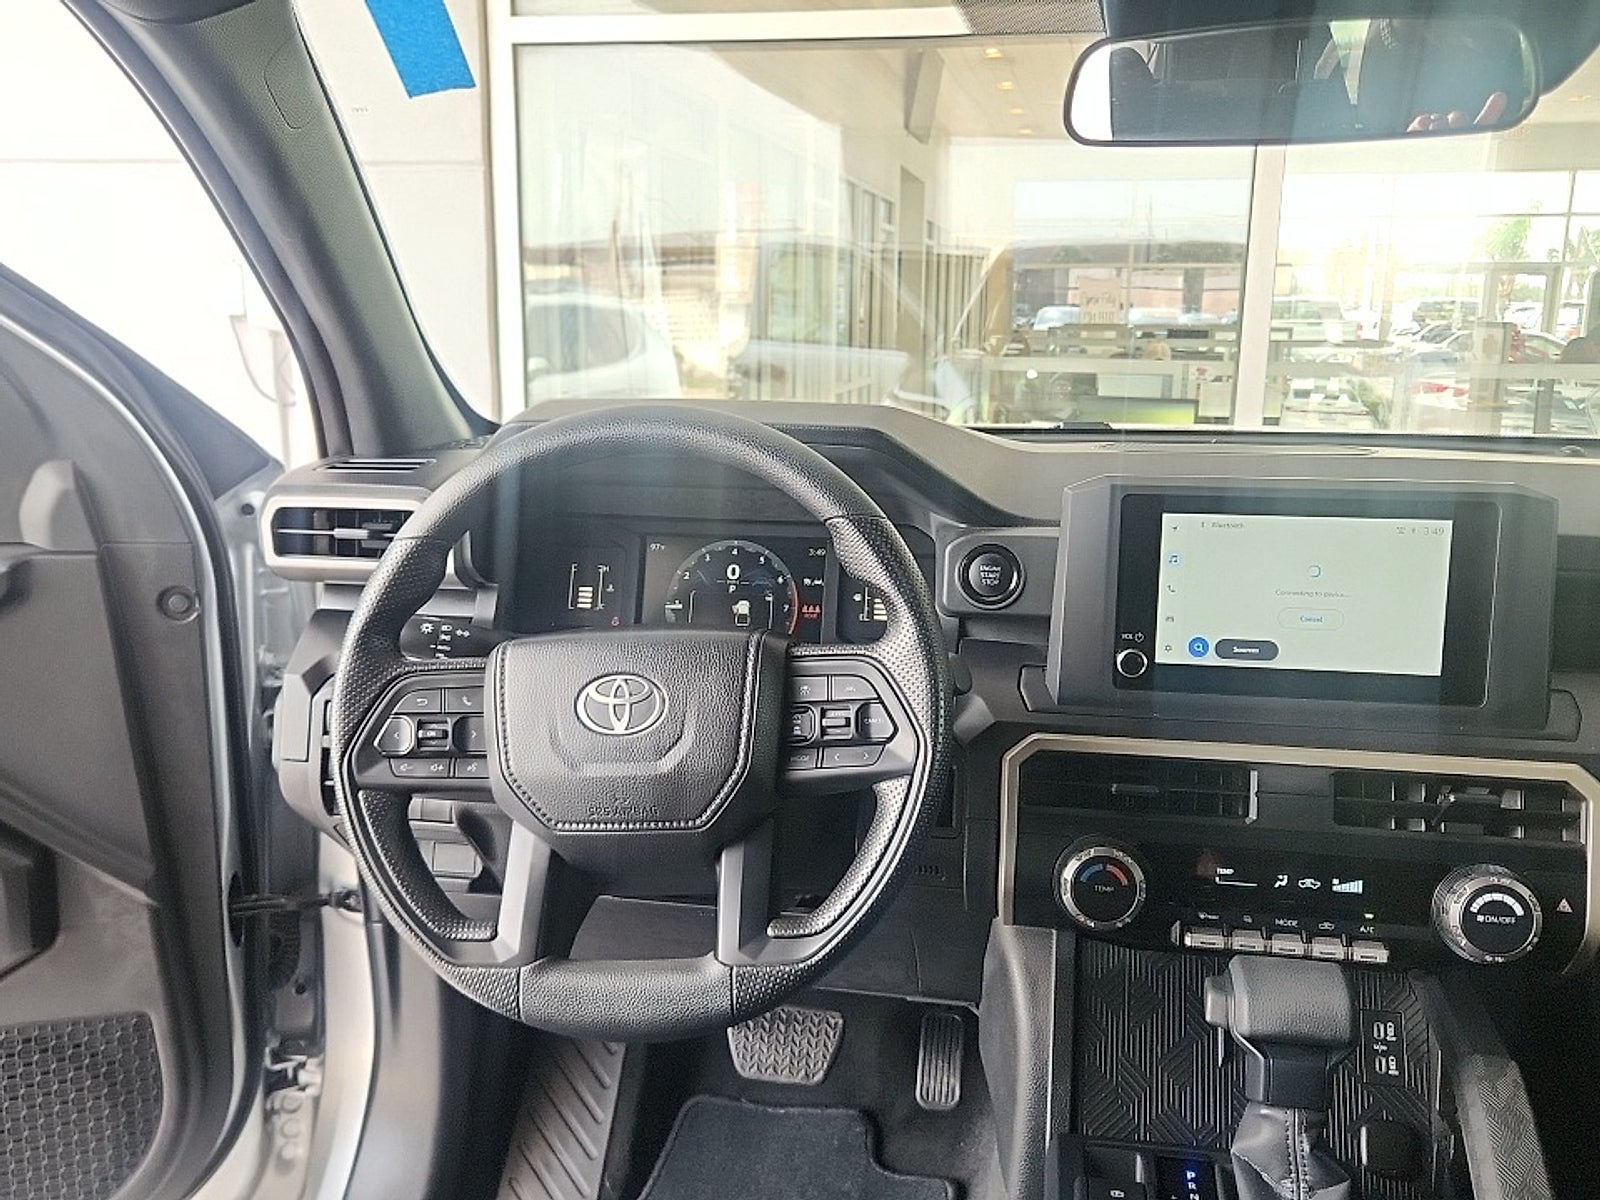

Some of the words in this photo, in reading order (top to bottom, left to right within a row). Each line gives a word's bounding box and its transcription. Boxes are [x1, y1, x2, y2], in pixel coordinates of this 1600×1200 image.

[1423, 526, 1445, 536] 3:49
[731, 548, 738, 556] 4
[759, 556, 766, 565] 5
[683, 572, 690, 580] 2
[726, 564, 740, 580] 0
[729, 584, 737, 593] P
[1275, 918, 1299, 928] MODE
[1484, 914, 1517, 925] ON/OFF
[1359, 925, 1376, 934] A/C
[1186, 1170, 1196, 1180] P
[1188, 1182, 1197, 1190] R
